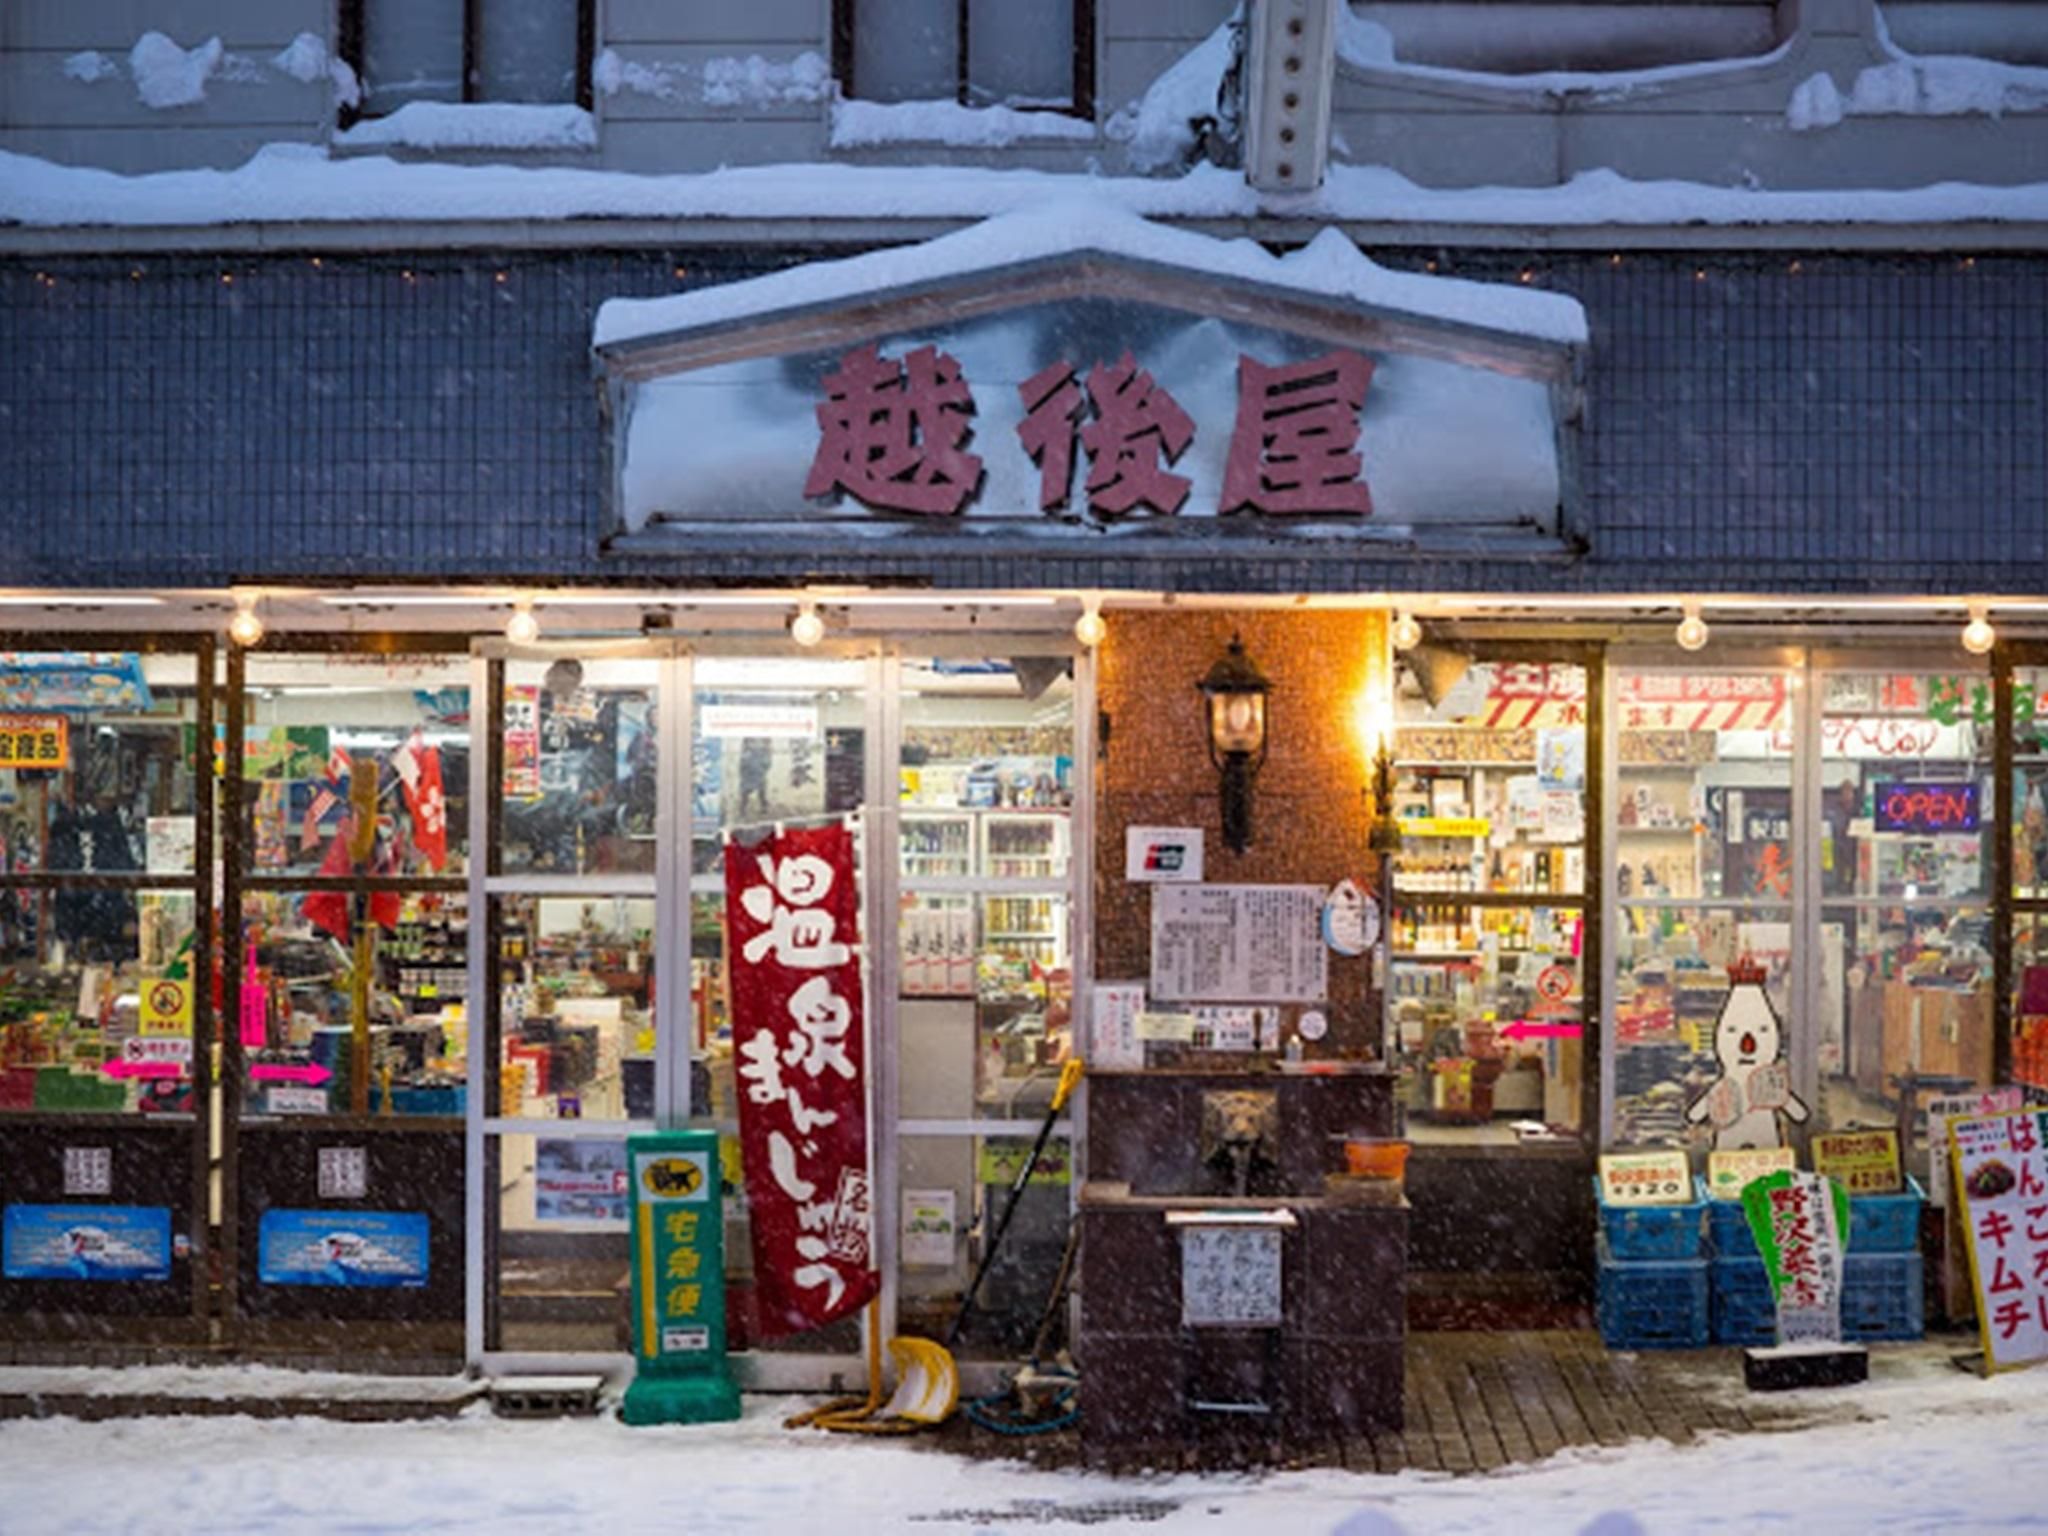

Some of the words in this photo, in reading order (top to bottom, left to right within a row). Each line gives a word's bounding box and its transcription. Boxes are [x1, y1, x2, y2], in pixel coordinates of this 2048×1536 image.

[804, 345, 1376, 516] 越後屋
[1886, 793, 1967, 822] OPEN
[665, 1210, 701, 1318] 宅急便
[1979, 1209, 2032, 1340] キムチ
